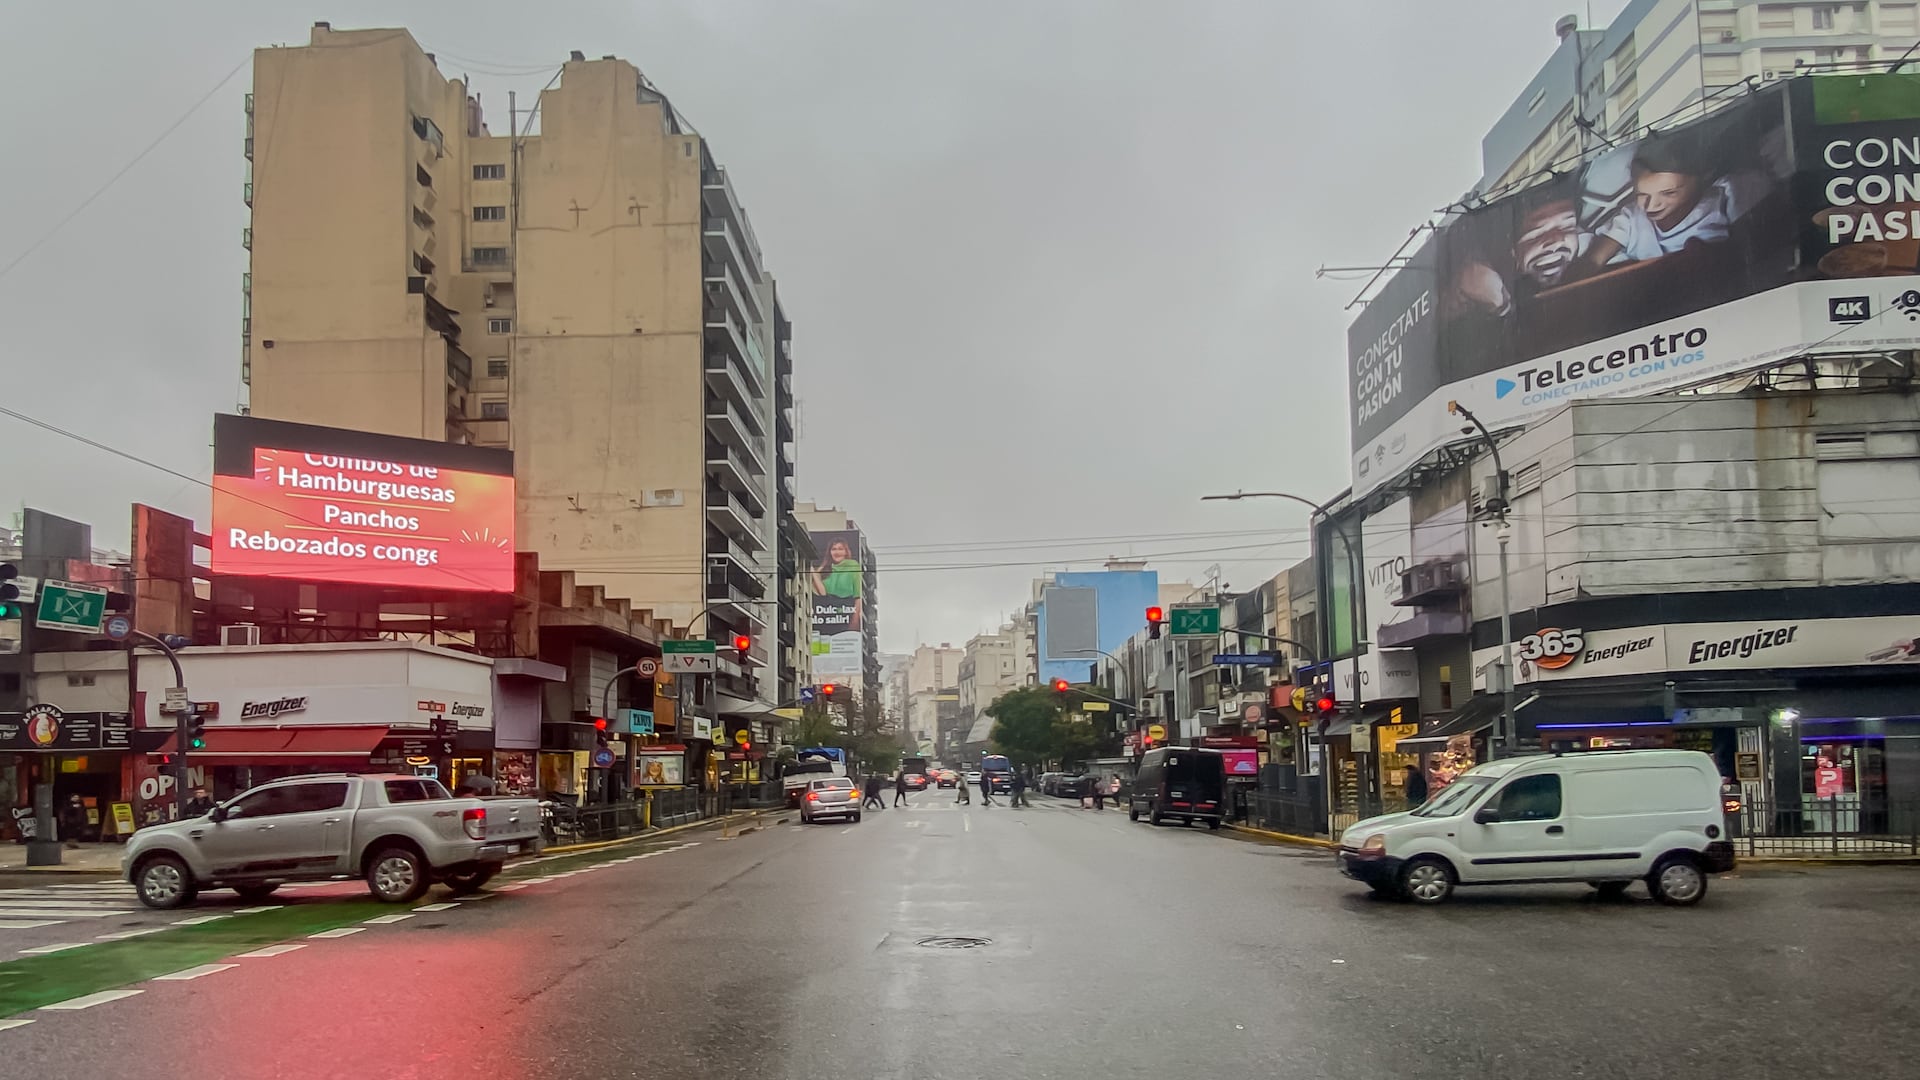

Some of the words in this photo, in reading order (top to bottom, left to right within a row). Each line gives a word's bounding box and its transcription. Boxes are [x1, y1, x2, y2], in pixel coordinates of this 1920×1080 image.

[1823, 136, 1920, 169] CON
[1825, 173, 1920, 206] CON
[1834, 301, 1864, 316] 4K
[1356, 290, 1430, 377] CONECTATE
[1357, 366, 1383, 400] CON
[1384, 344, 1403, 375] TU
[1518, 327, 1708, 393] Telecentro
[1521, 371, 1625, 407] CONECTANDO
[1628, 360, 1665, 378] CON
[1672, 349, 1705, 368] VOS
[1358, 372, 1402, 426] PASIÓN
[278, 466, 456, 504] Hamburguesas
[324, 504, 420, 531] Panchos
[229, 527, 367, 559] Rebozados
[1368, 556, 1406, 588] VITTO
[1519, 627, 1586, 661] 365
[1583, 636, 1655, 665] Energizer
[1688, 625, 1798, 665] Energizer
[1344, 670, 1369, 689] VIO
[241, 696, 306, 718] Energizer
[451, 701, 485, 719] Energizer
[140, 765, 205, 800] OPN
